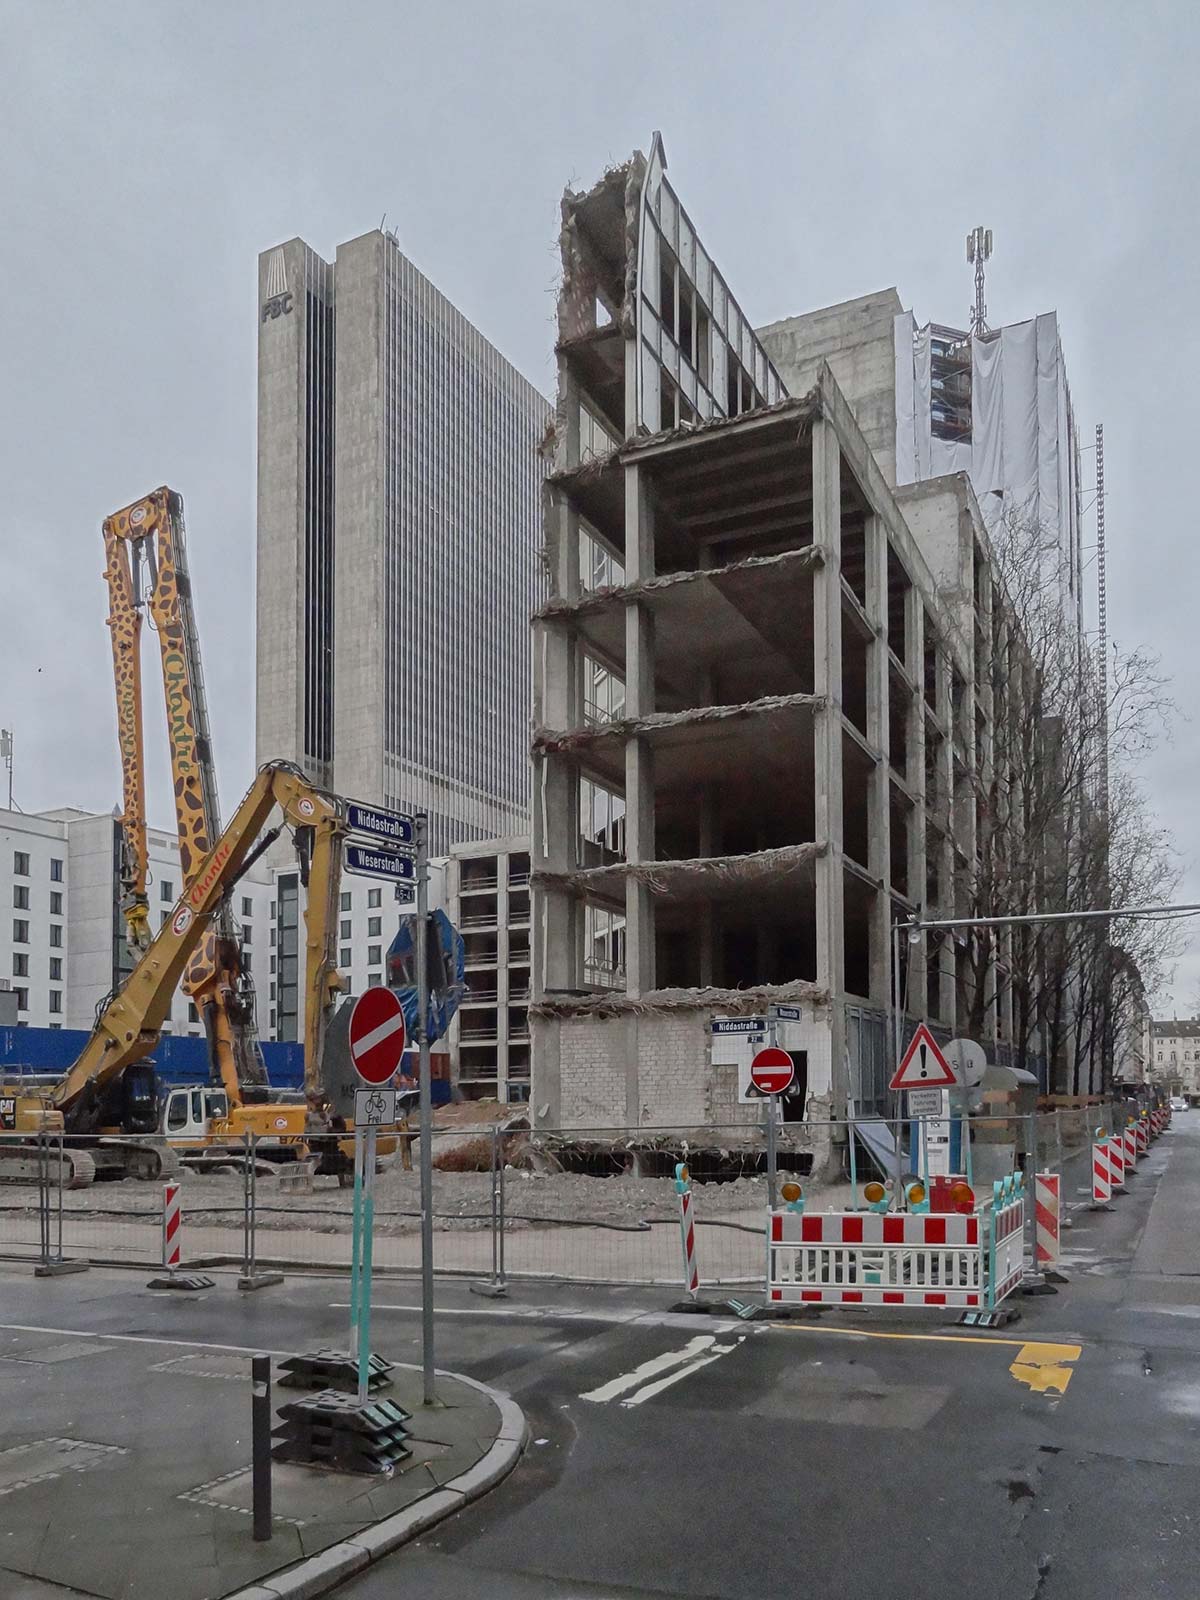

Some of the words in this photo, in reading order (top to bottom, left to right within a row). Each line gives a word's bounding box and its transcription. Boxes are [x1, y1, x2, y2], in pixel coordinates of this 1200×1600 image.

[357, 809, 404, 837] Niddastraße
[357, 850, 404, 874] Weserstraße
[718, 1021, 758, 1031] Niddastraße
[0, 1099, 15, 1114] CAT
[367, 1114, 382, 1124] Frei
